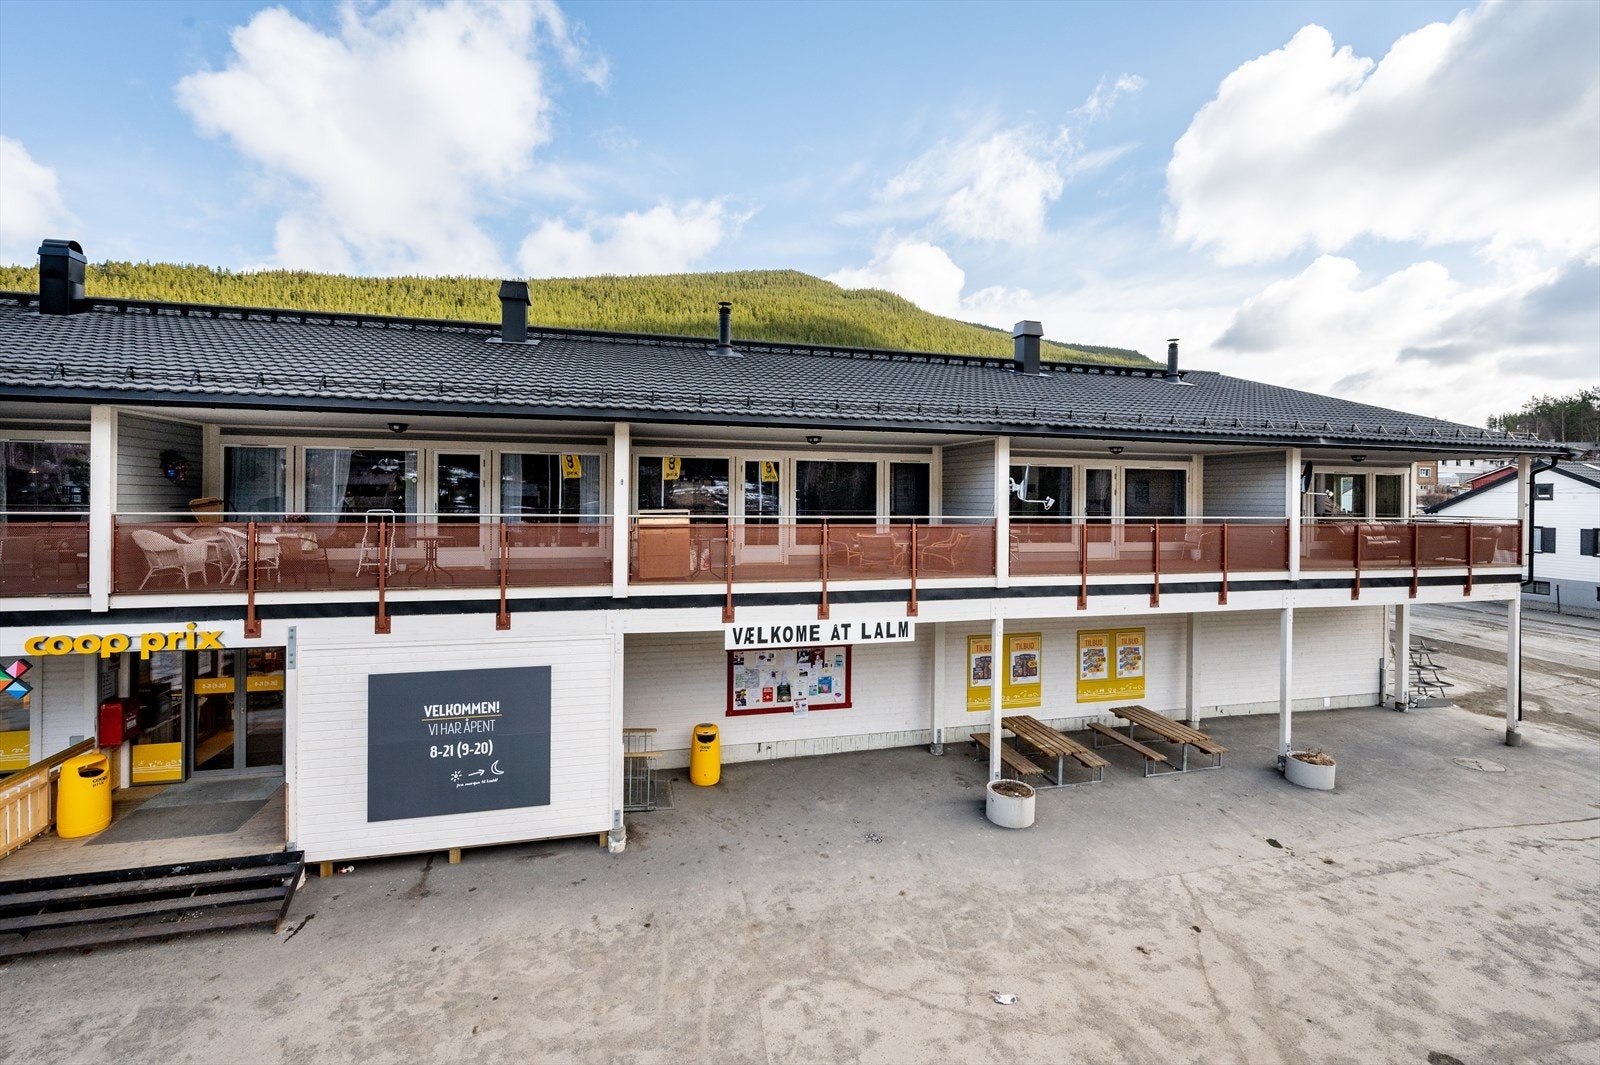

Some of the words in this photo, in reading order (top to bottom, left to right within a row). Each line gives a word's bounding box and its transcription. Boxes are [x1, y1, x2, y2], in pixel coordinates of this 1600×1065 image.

[24, 633, 130, 658] coop
[140, 622, 225, 660] prix
[732, 624, 820, 645] VÆLKOME
[861, 621, 909, 640] LALM
[976, 644, 992, 652] TILBU
[1016, 642, 1034, 650] TILBUD
[424, 701, 500, 718] VELKOMMEN!
[428, 724, 438, 736] VI
[440, 722, 462, 735] HAR
[464, 718, 496, 734] ÅPENT
[430, 744, 454, 758] 8-21
[457, 740, 493, 759] (9-20)
